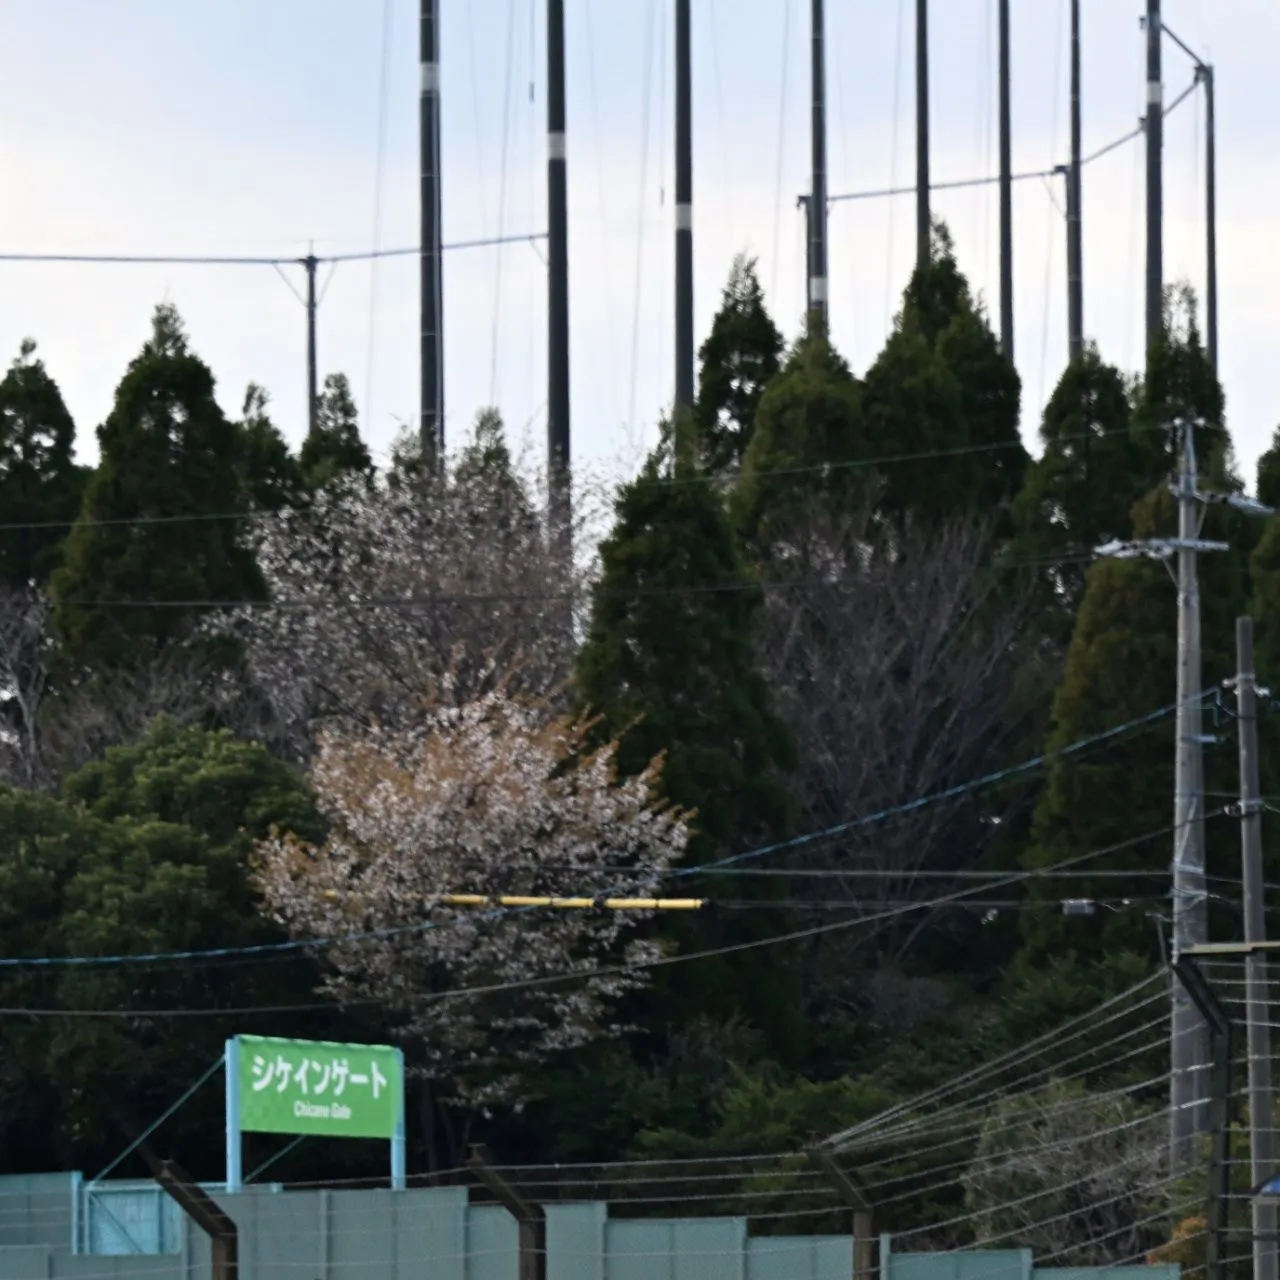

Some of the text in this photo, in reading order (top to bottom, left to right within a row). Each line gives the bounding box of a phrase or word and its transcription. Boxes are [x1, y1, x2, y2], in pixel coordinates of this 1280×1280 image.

[251, 1055, 388, 1099] シケインゲート
